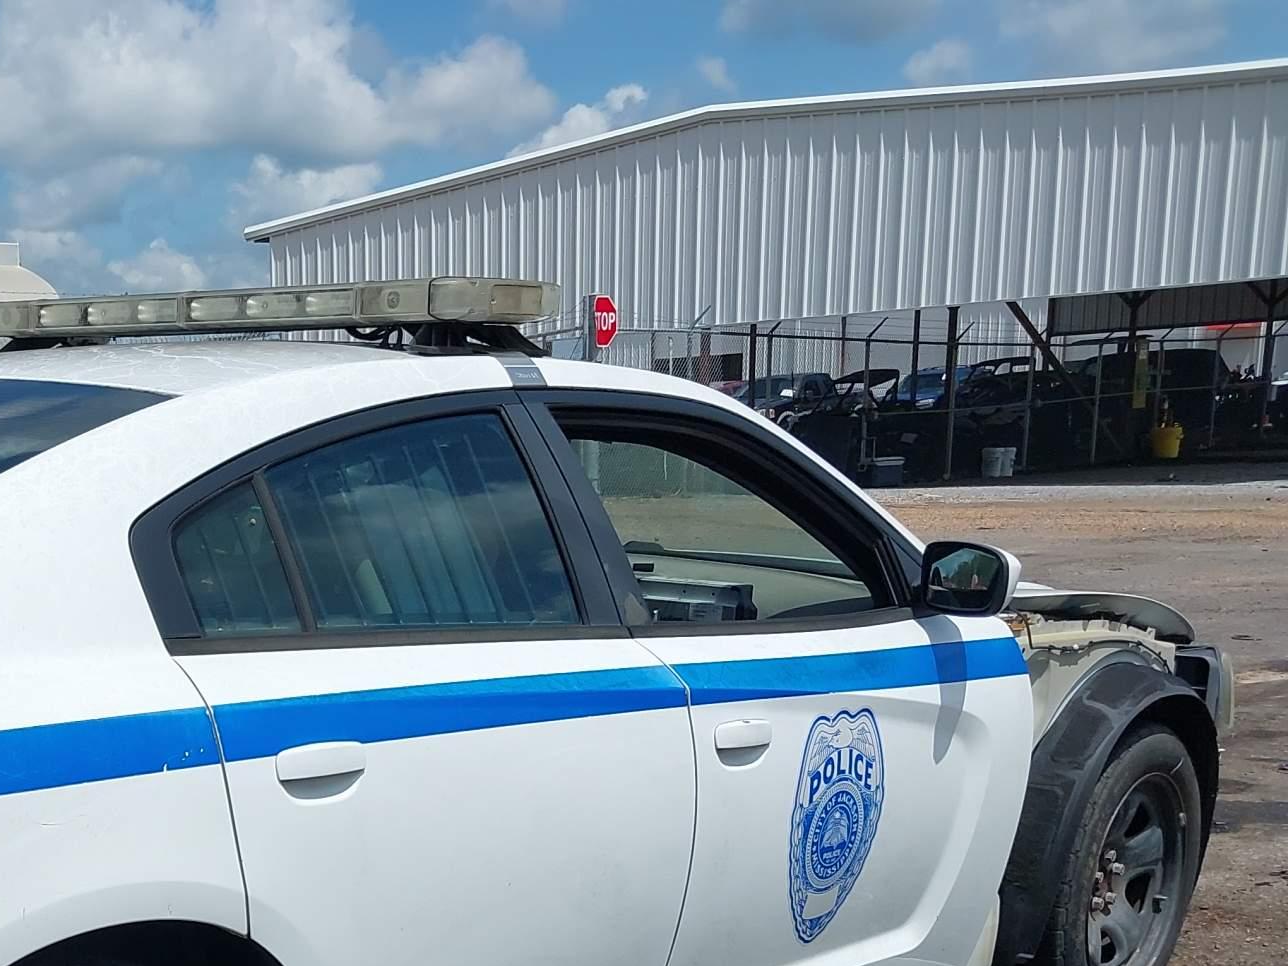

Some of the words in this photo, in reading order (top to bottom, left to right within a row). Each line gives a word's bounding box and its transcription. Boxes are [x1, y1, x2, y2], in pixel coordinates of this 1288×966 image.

[595, 312, 615, 330] TOP
[809, 749, 874, 804] POLICE
[826, 795, 837, 811] OF
